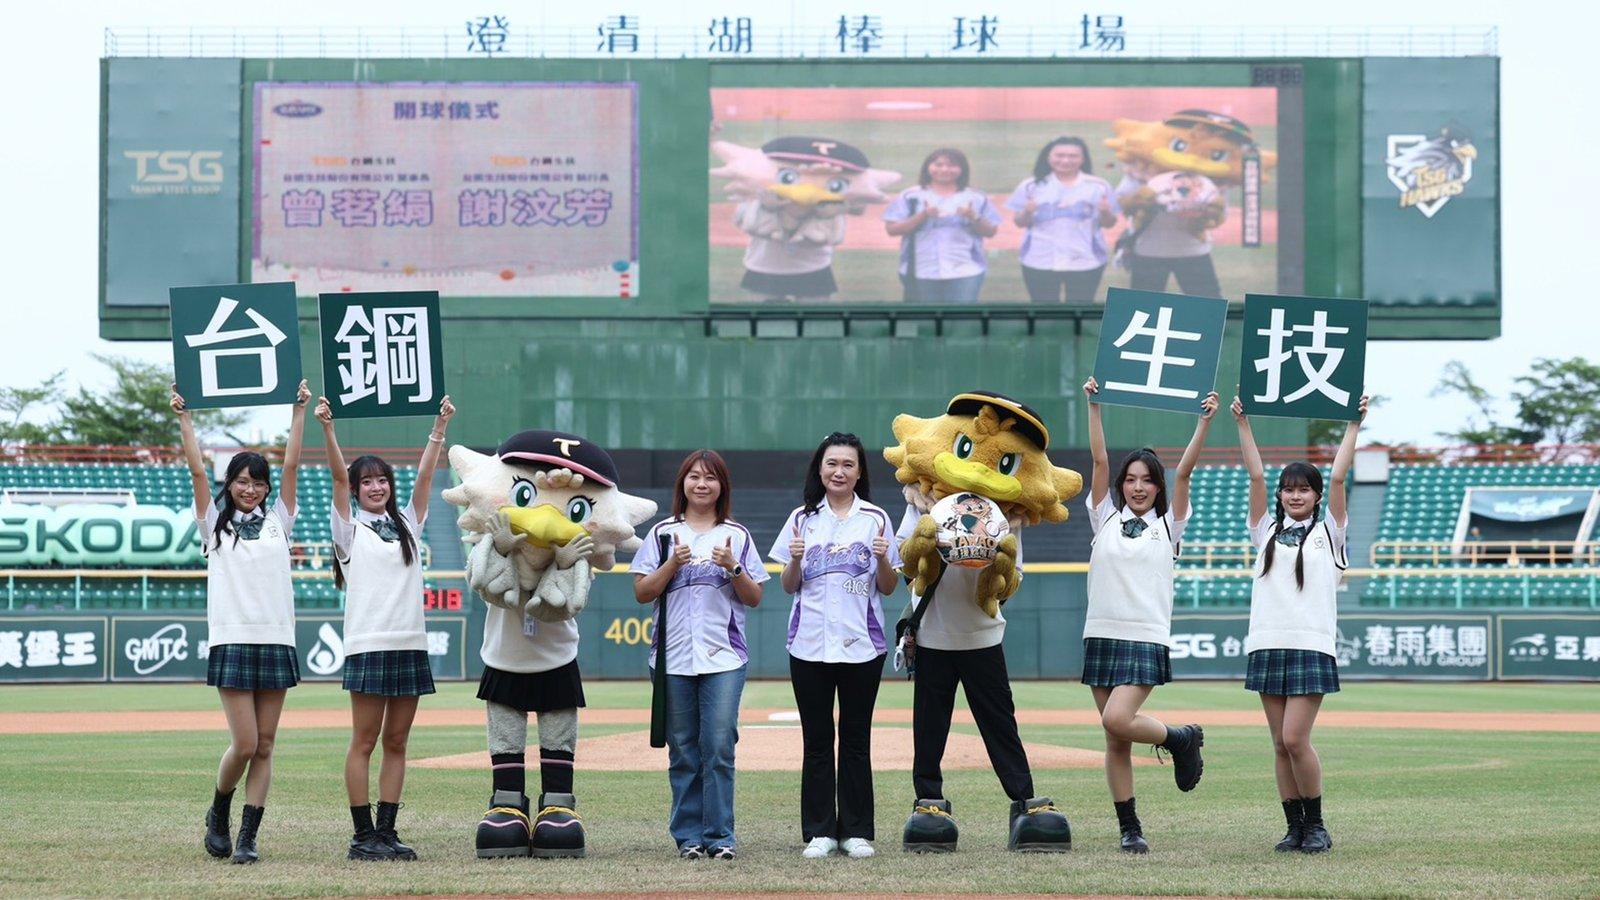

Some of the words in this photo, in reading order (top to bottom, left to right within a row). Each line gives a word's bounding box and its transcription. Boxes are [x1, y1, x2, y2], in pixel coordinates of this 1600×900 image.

[466, 14, 1126, 54] 澄清湖棒球場
[393, 101, 499, 120] 開球儀式
[123, 150, 224, 183] TSG
[458, 188, 613, 227] 謝汶芳
[184, 296, 288, 398] 台
[334, 304, 434, 407] 鋼
[1104, 306, 1202, 400] 生
[1253, 308, 1351, 408] 技
[552, 438, 581, 457] T
[604, 617, 653, 645] 400
[1221, 635, 1249, 657] 台
[1364, 624, 1487, 656] 春雨集團
[125, 637, 188, 661] GMTC
[1367, 655, 1408, 666] CHUN
[1413, 655, 1432, 666] YU
[1436, 655, 1487, 667] GROUP
